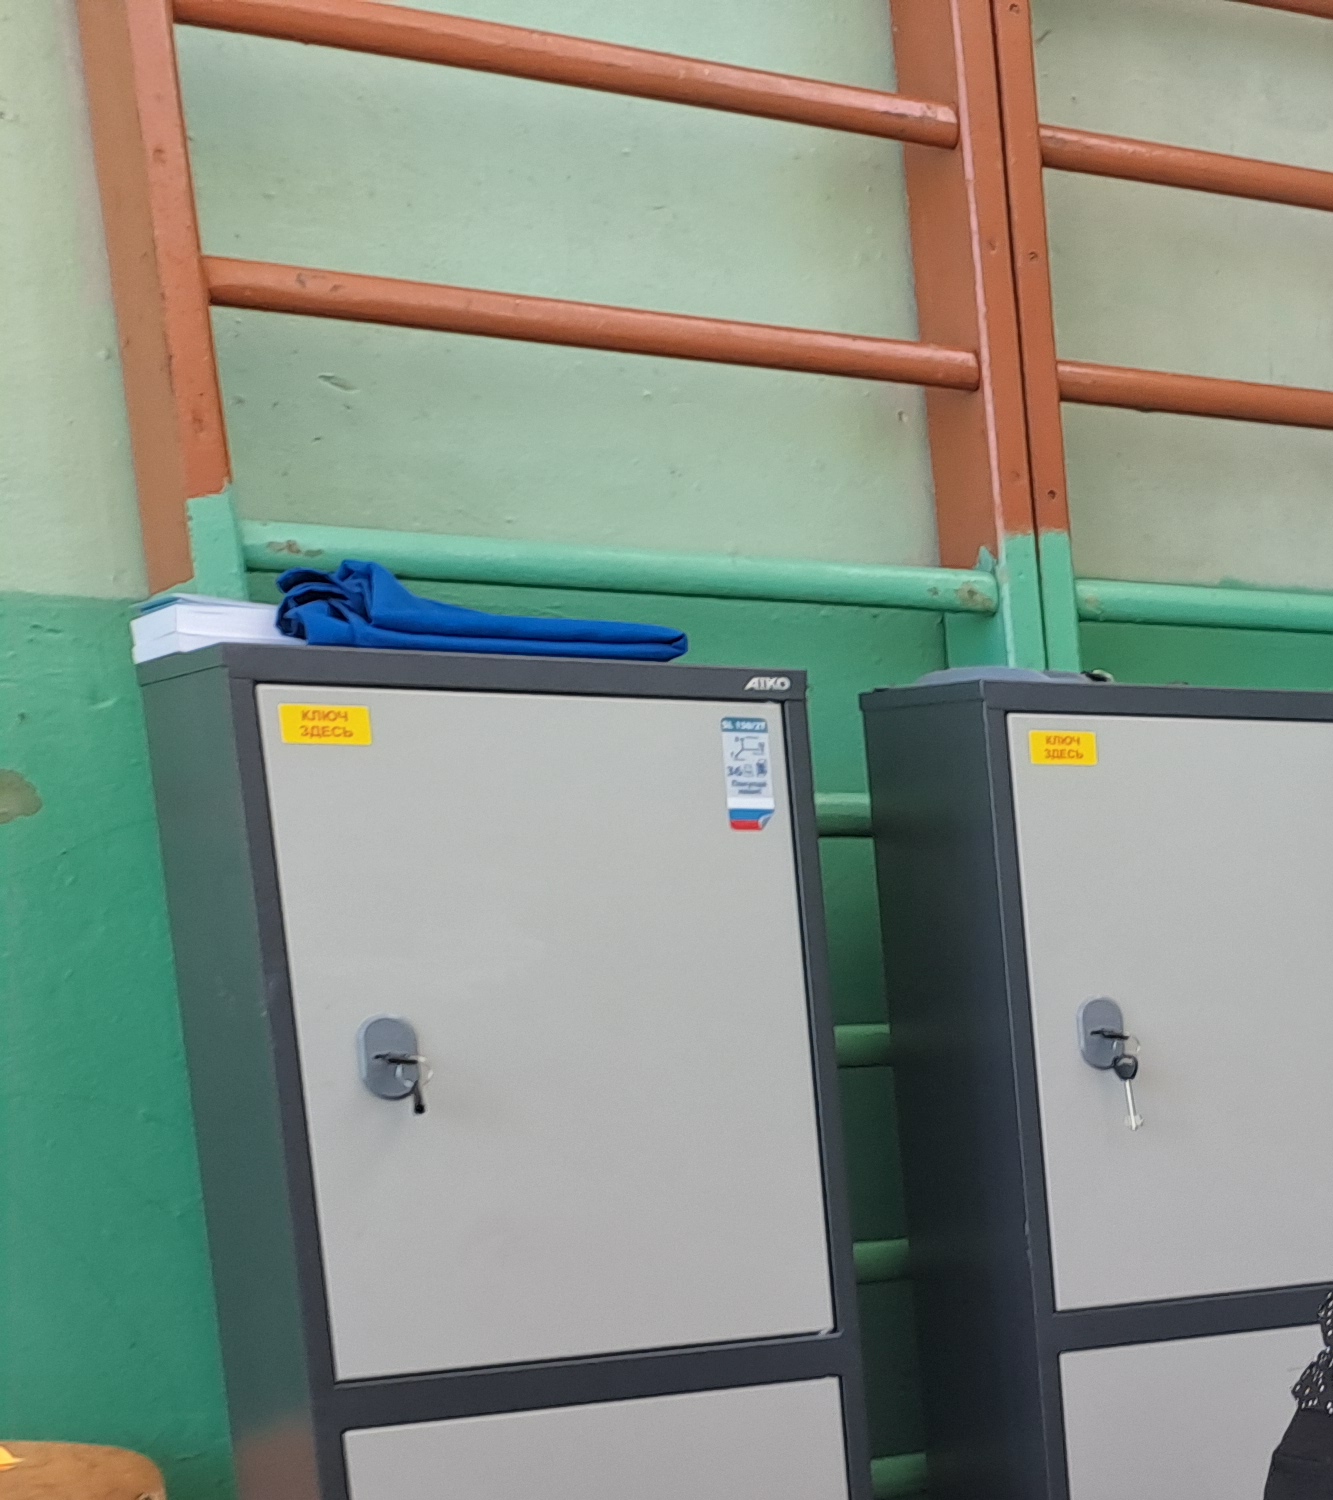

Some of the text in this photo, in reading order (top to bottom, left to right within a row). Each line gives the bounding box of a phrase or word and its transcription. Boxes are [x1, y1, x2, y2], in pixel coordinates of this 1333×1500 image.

[744, 676, 791, 691] AIKO
[301, 710, 348, 722] КЛЮЧ
[299, 725, 354, 739] ЗДЕСЬ
[1045, 735, 1081, 747] КЛЮЧ
[1043, 748, 1084, 760] ЗДЕСЬ
